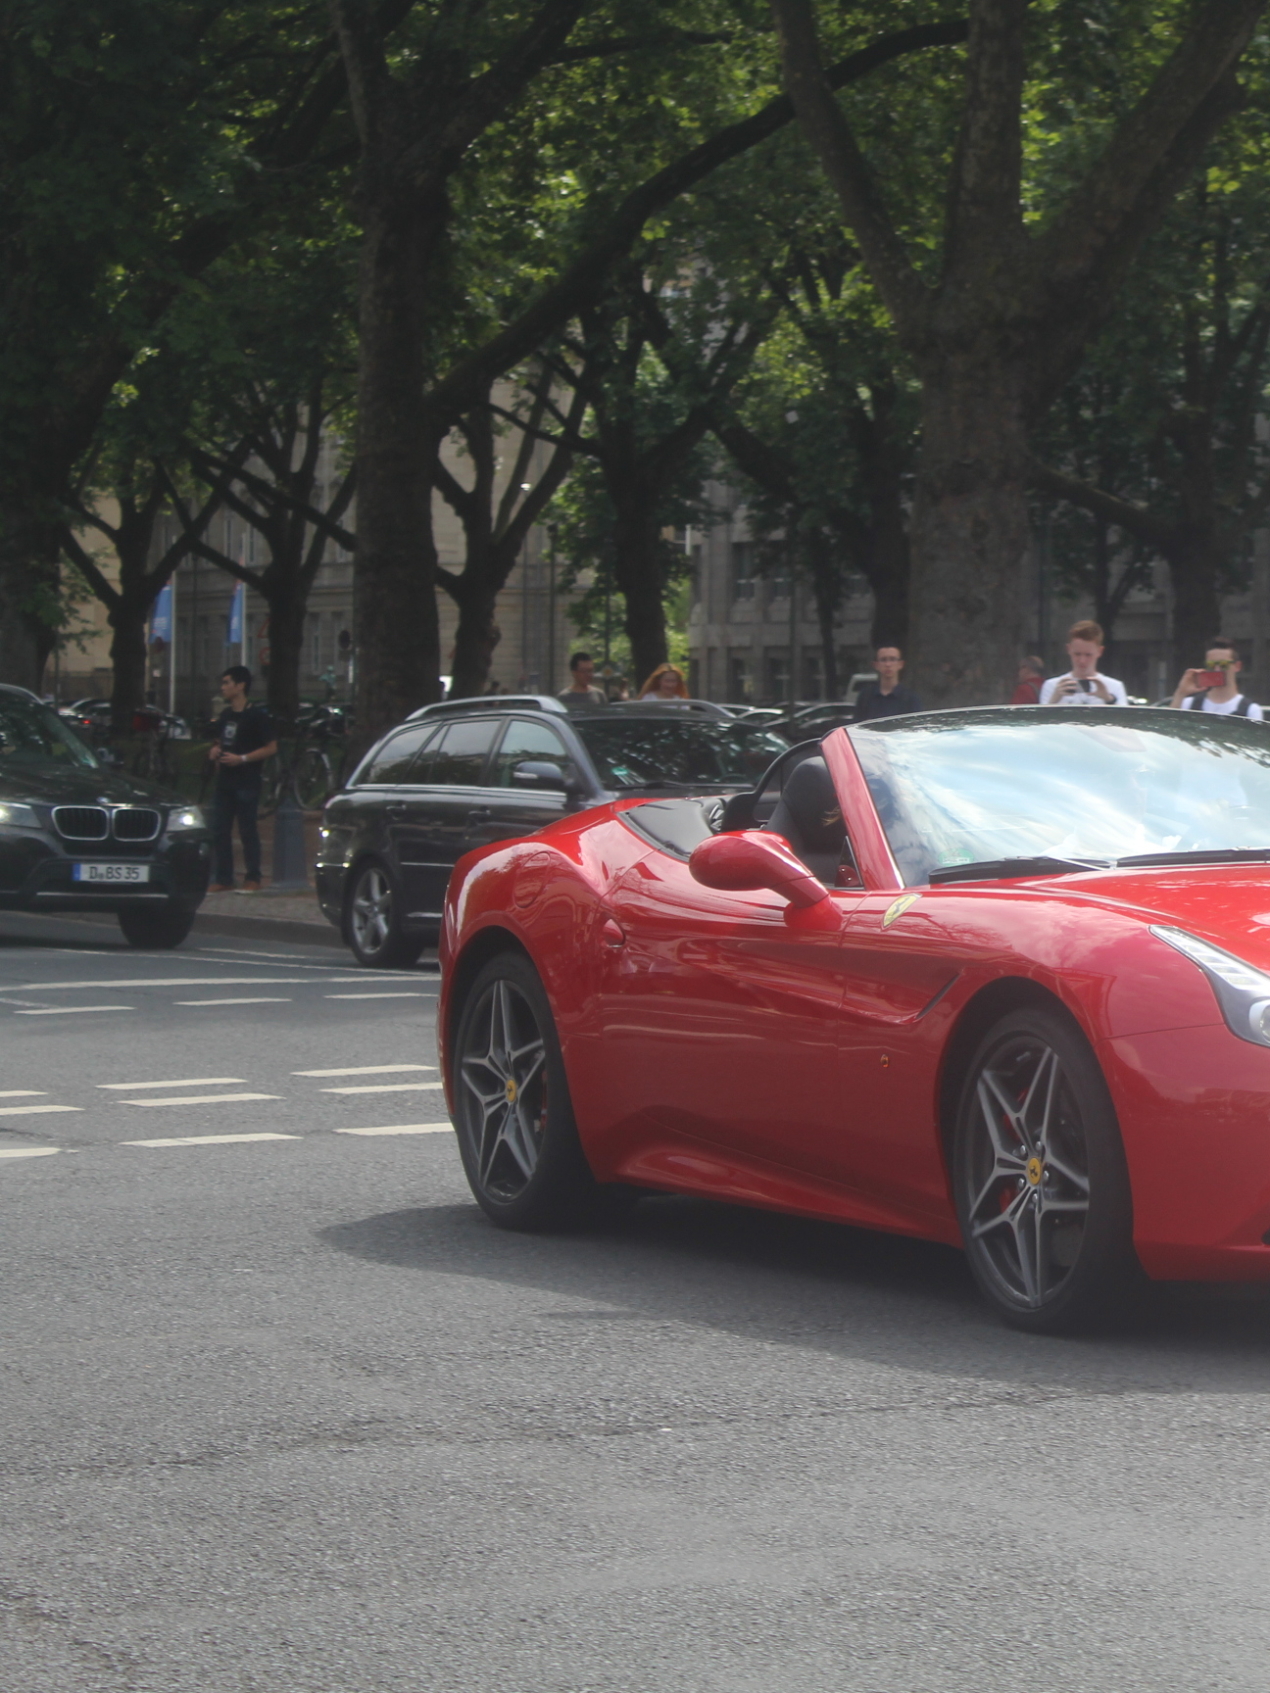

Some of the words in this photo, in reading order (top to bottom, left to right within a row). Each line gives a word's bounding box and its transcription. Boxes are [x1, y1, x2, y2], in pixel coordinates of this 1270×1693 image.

[89, 866, 98, 880] D
[106, 866, 122, 880] BS
[125, 866, 140, 881] 35
